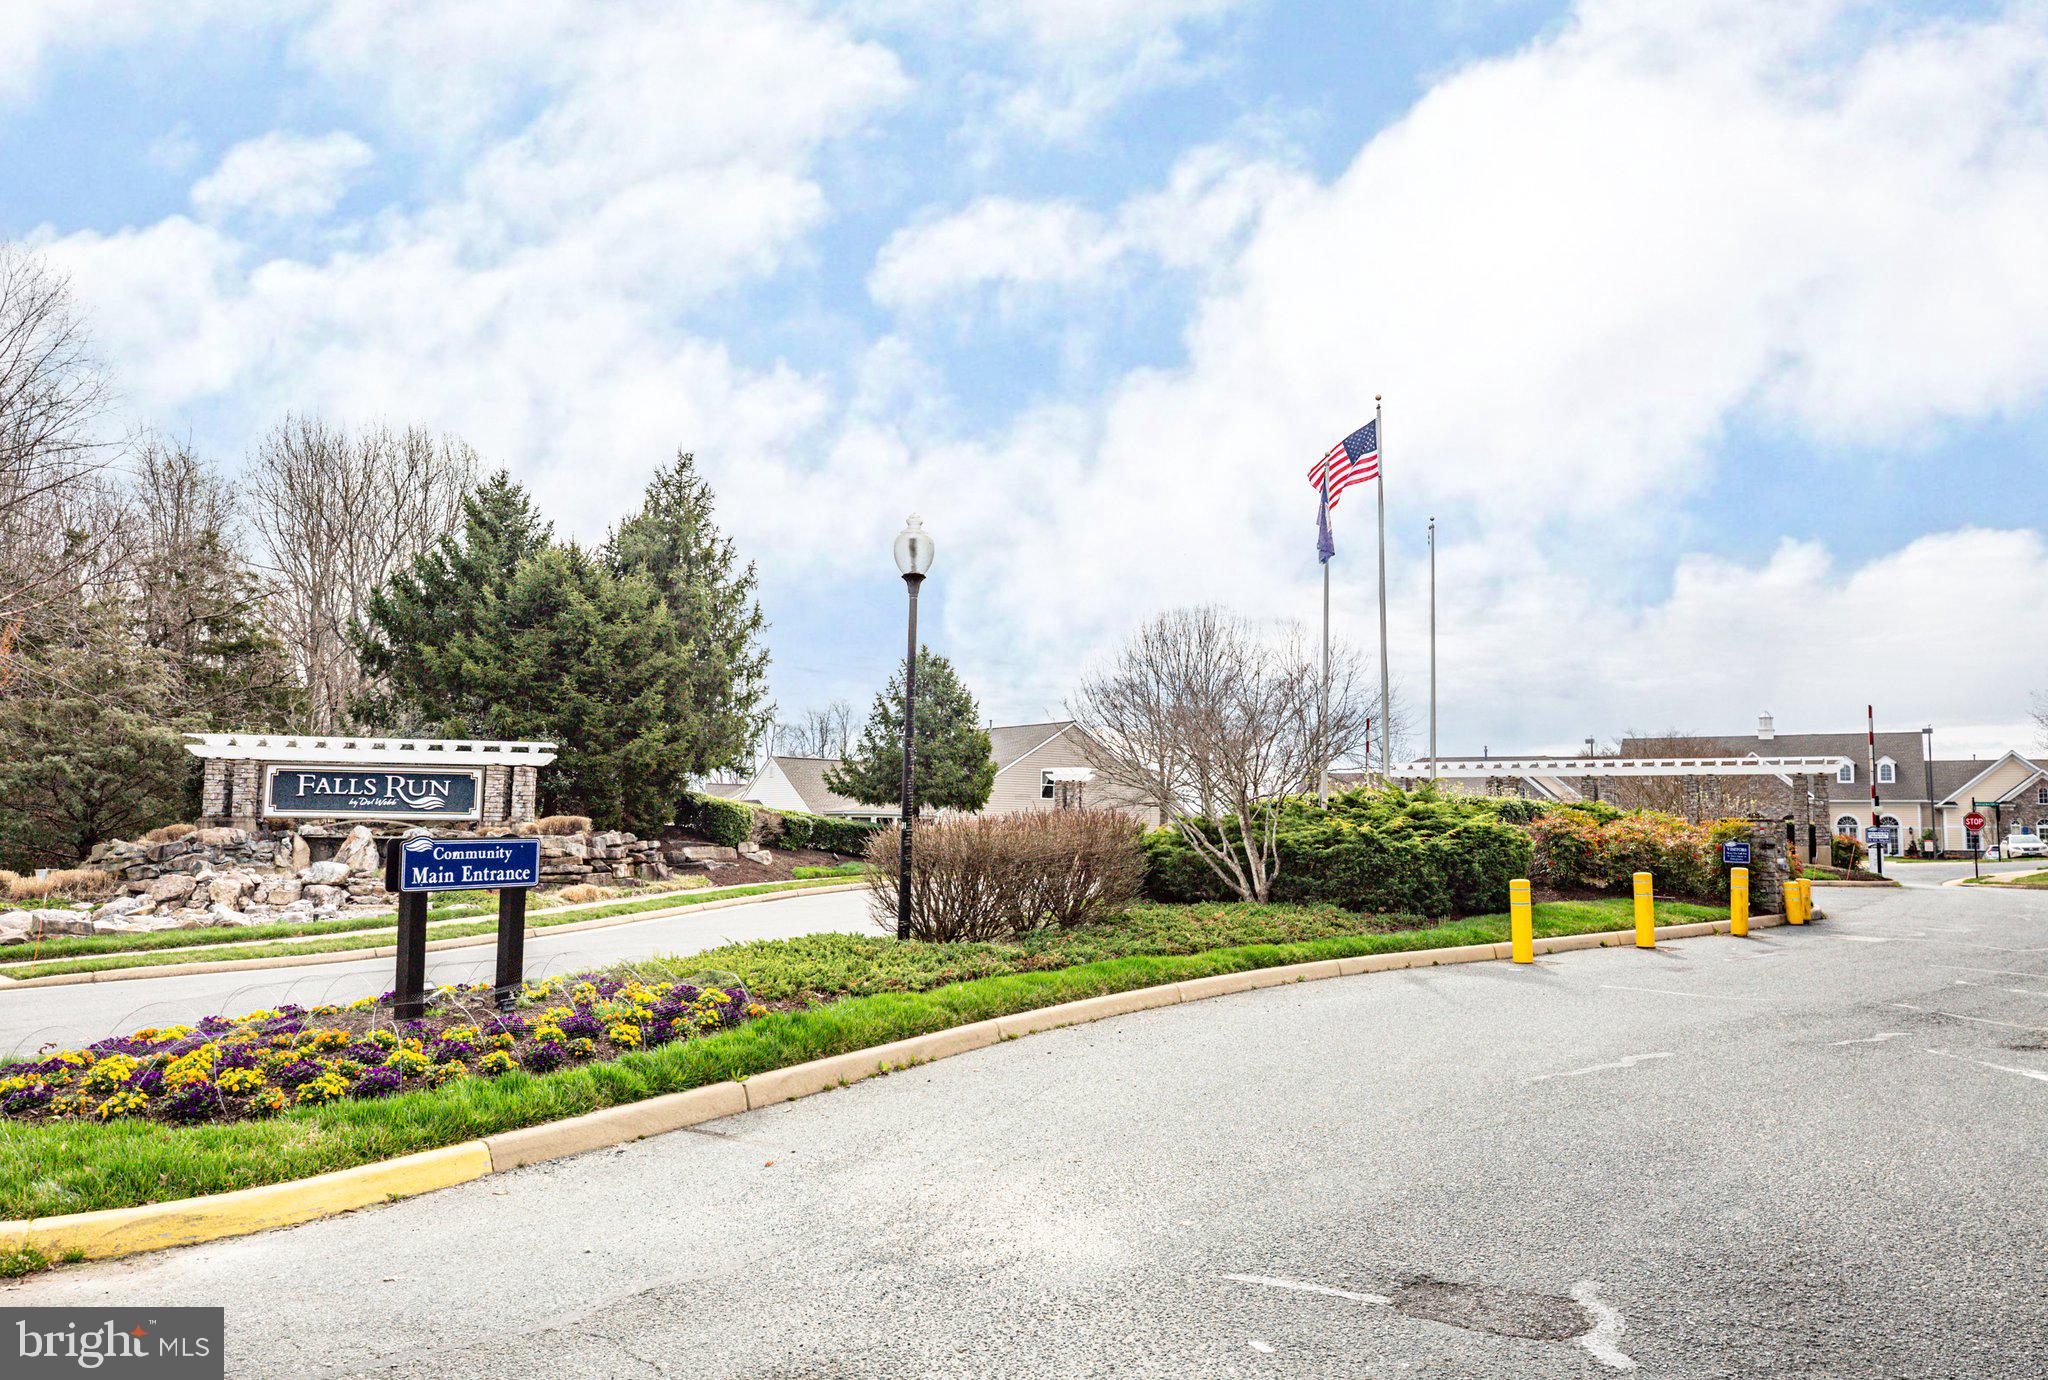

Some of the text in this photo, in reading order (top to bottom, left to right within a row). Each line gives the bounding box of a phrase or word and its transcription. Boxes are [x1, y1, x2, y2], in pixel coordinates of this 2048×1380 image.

[296, 774, 451, 798] FALLS RUN
[348, 798, 358, 808] by
[433, 846, 513, 863] Community
[411, 865, 531, 884] Main Entrance
